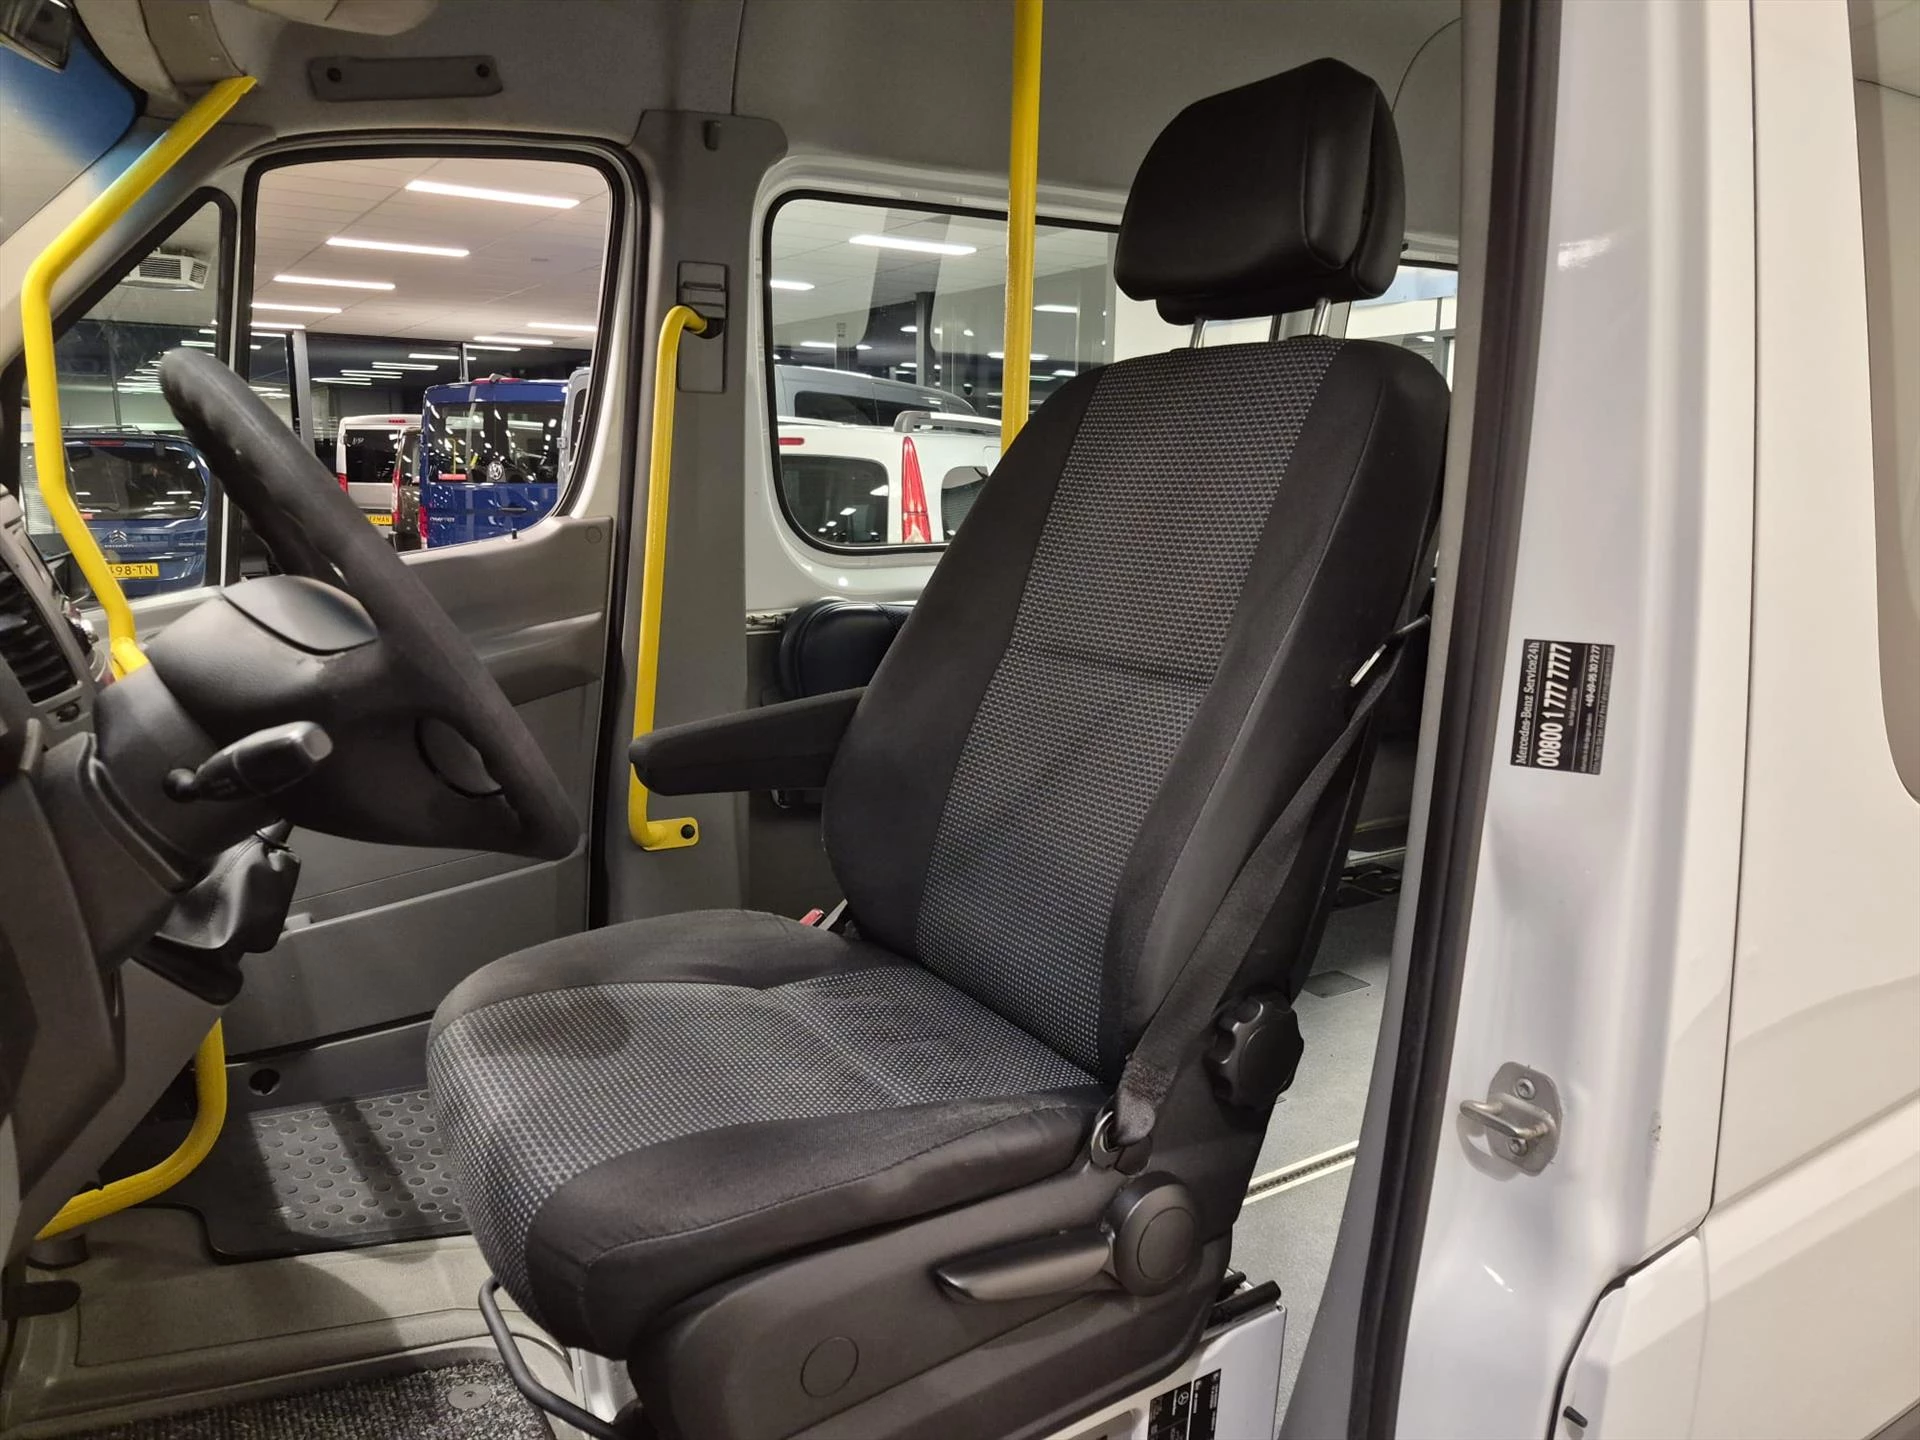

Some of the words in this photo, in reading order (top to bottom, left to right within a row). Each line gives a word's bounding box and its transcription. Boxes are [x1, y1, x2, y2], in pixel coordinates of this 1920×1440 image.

[110, 565, 153, 576] 98-TN
[1523, 641, 1541, 694] Service24h
[1546, 642, 1572, 680] 7777
[1543, 680, 1568, 709] 777
[1515, 694, 1534, 765] Mercedes-Benz
[1541, 711, 1565, 719] 1
[1536, 722, 1563, 768] 00800
